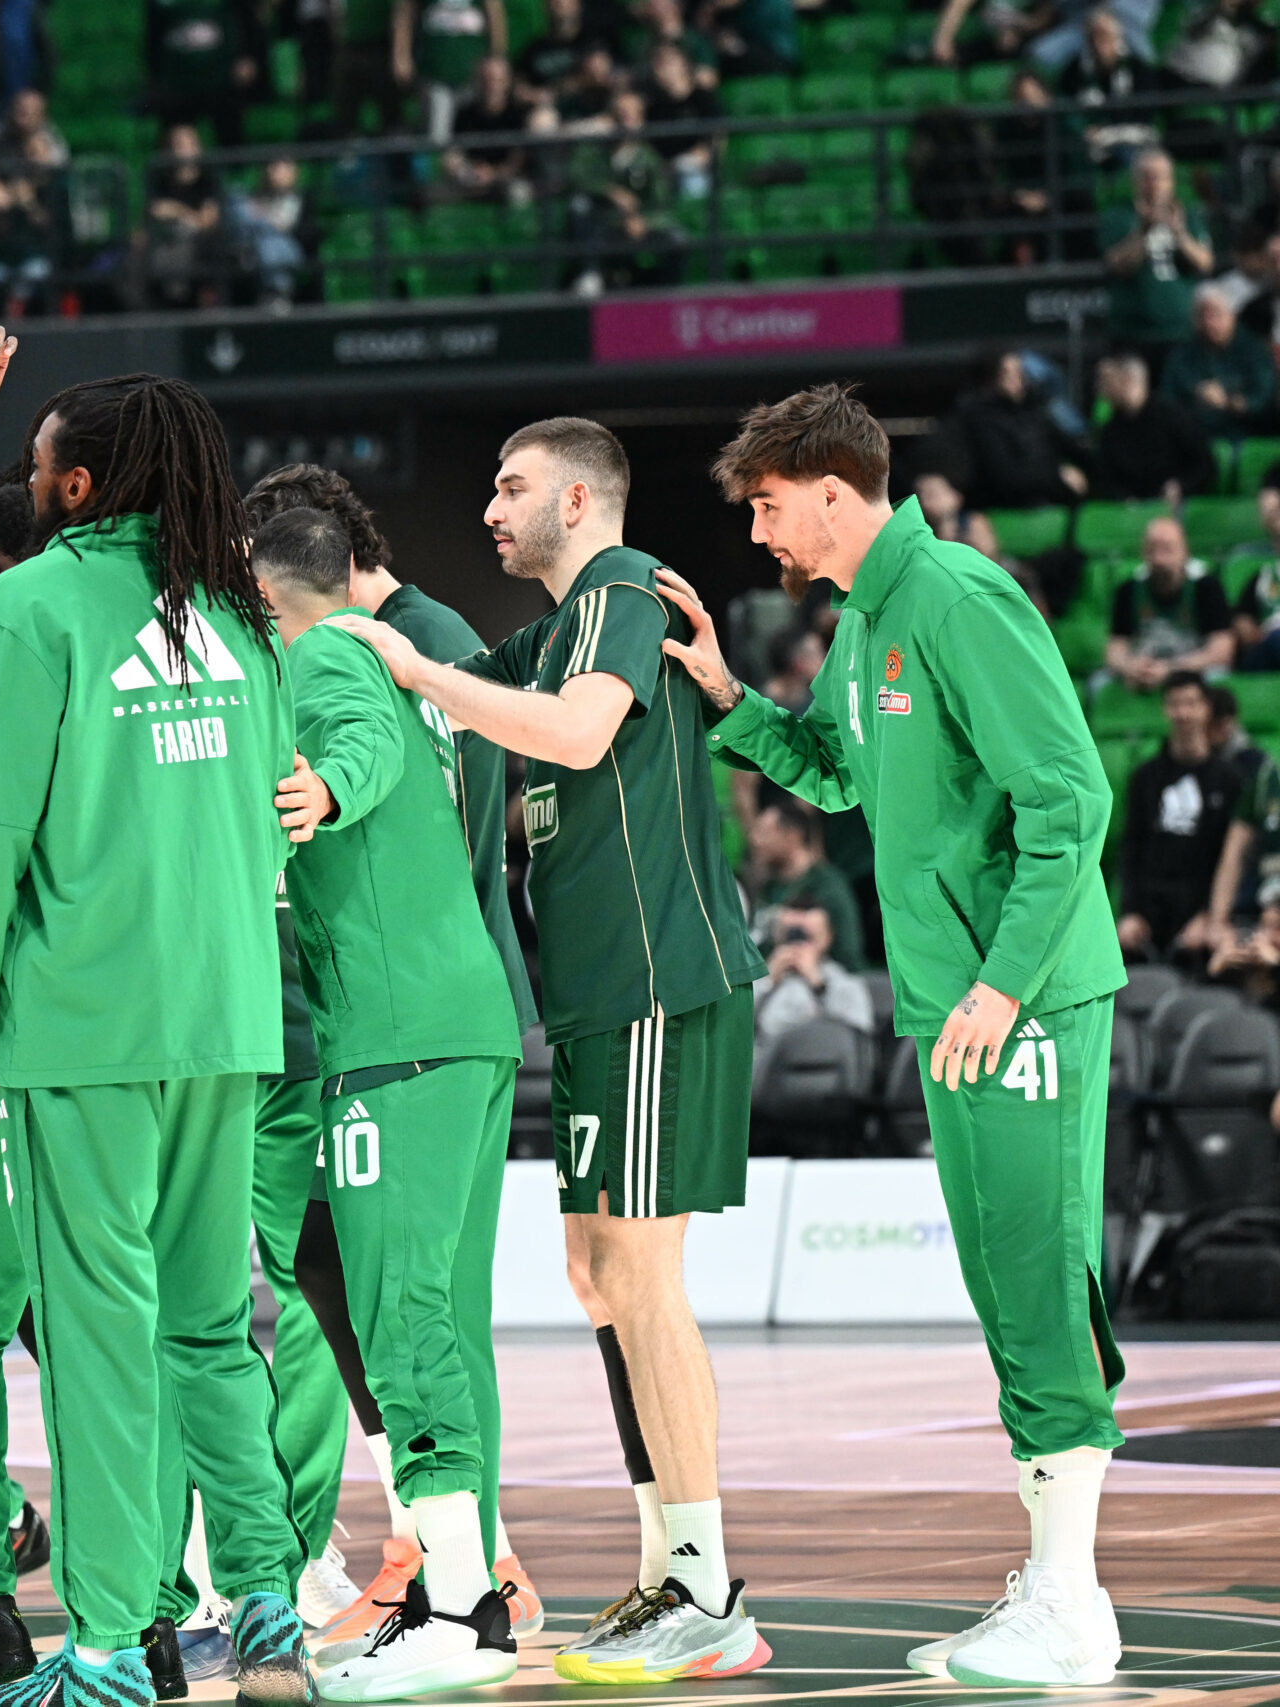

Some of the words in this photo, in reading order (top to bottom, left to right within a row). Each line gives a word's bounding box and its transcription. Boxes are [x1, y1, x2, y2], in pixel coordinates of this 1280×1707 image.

[151, 716, 228, 765] FARIED
[1000, 1039, 1058, 1102] 41
[332, 1121, 381, 1189] 10
[799, 1221, 952, 1252] COSMOT
